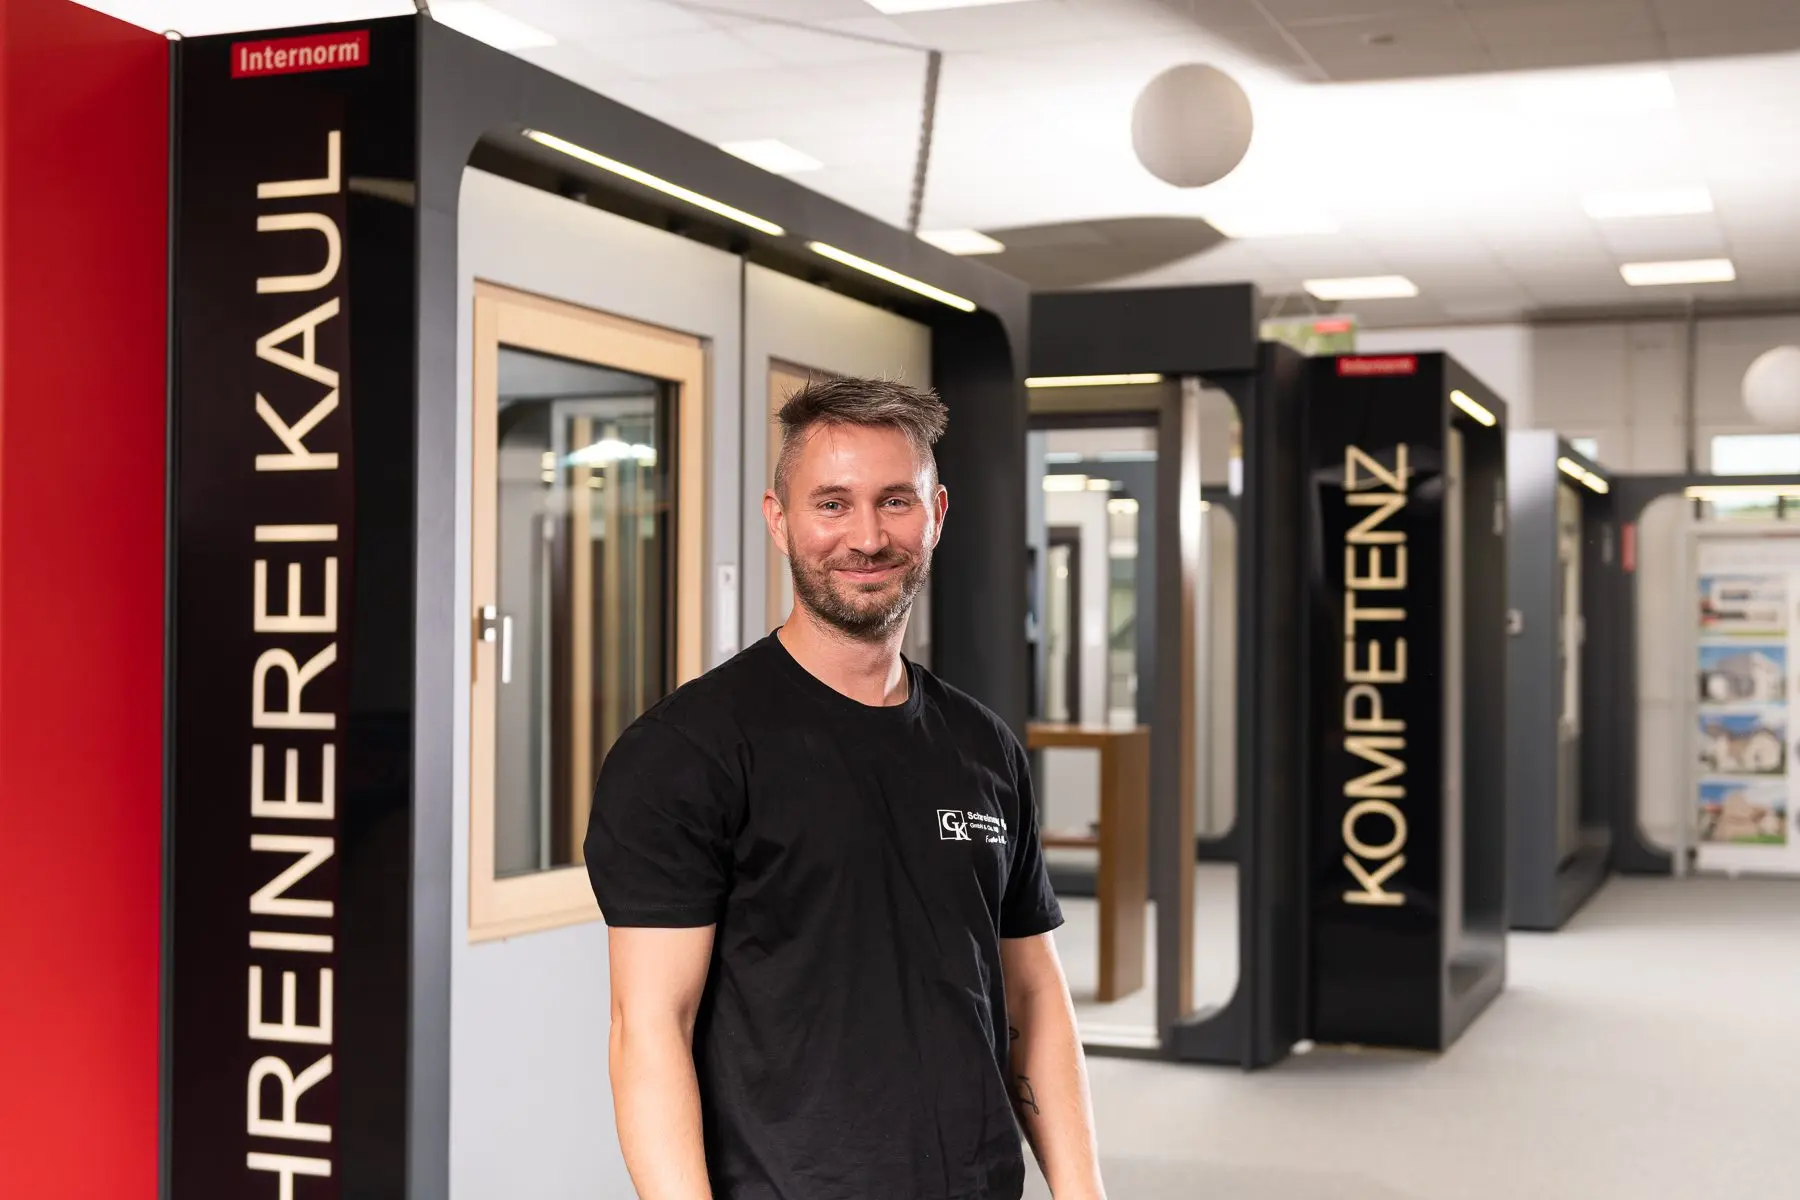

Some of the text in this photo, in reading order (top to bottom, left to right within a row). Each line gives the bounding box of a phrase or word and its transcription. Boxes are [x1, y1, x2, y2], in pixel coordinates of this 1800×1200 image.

[240, 42, 359, 71] Internorm
[255, 130, 342, 471] KAUL
[1342, 442, 1408, 905] KOMPETENZ
